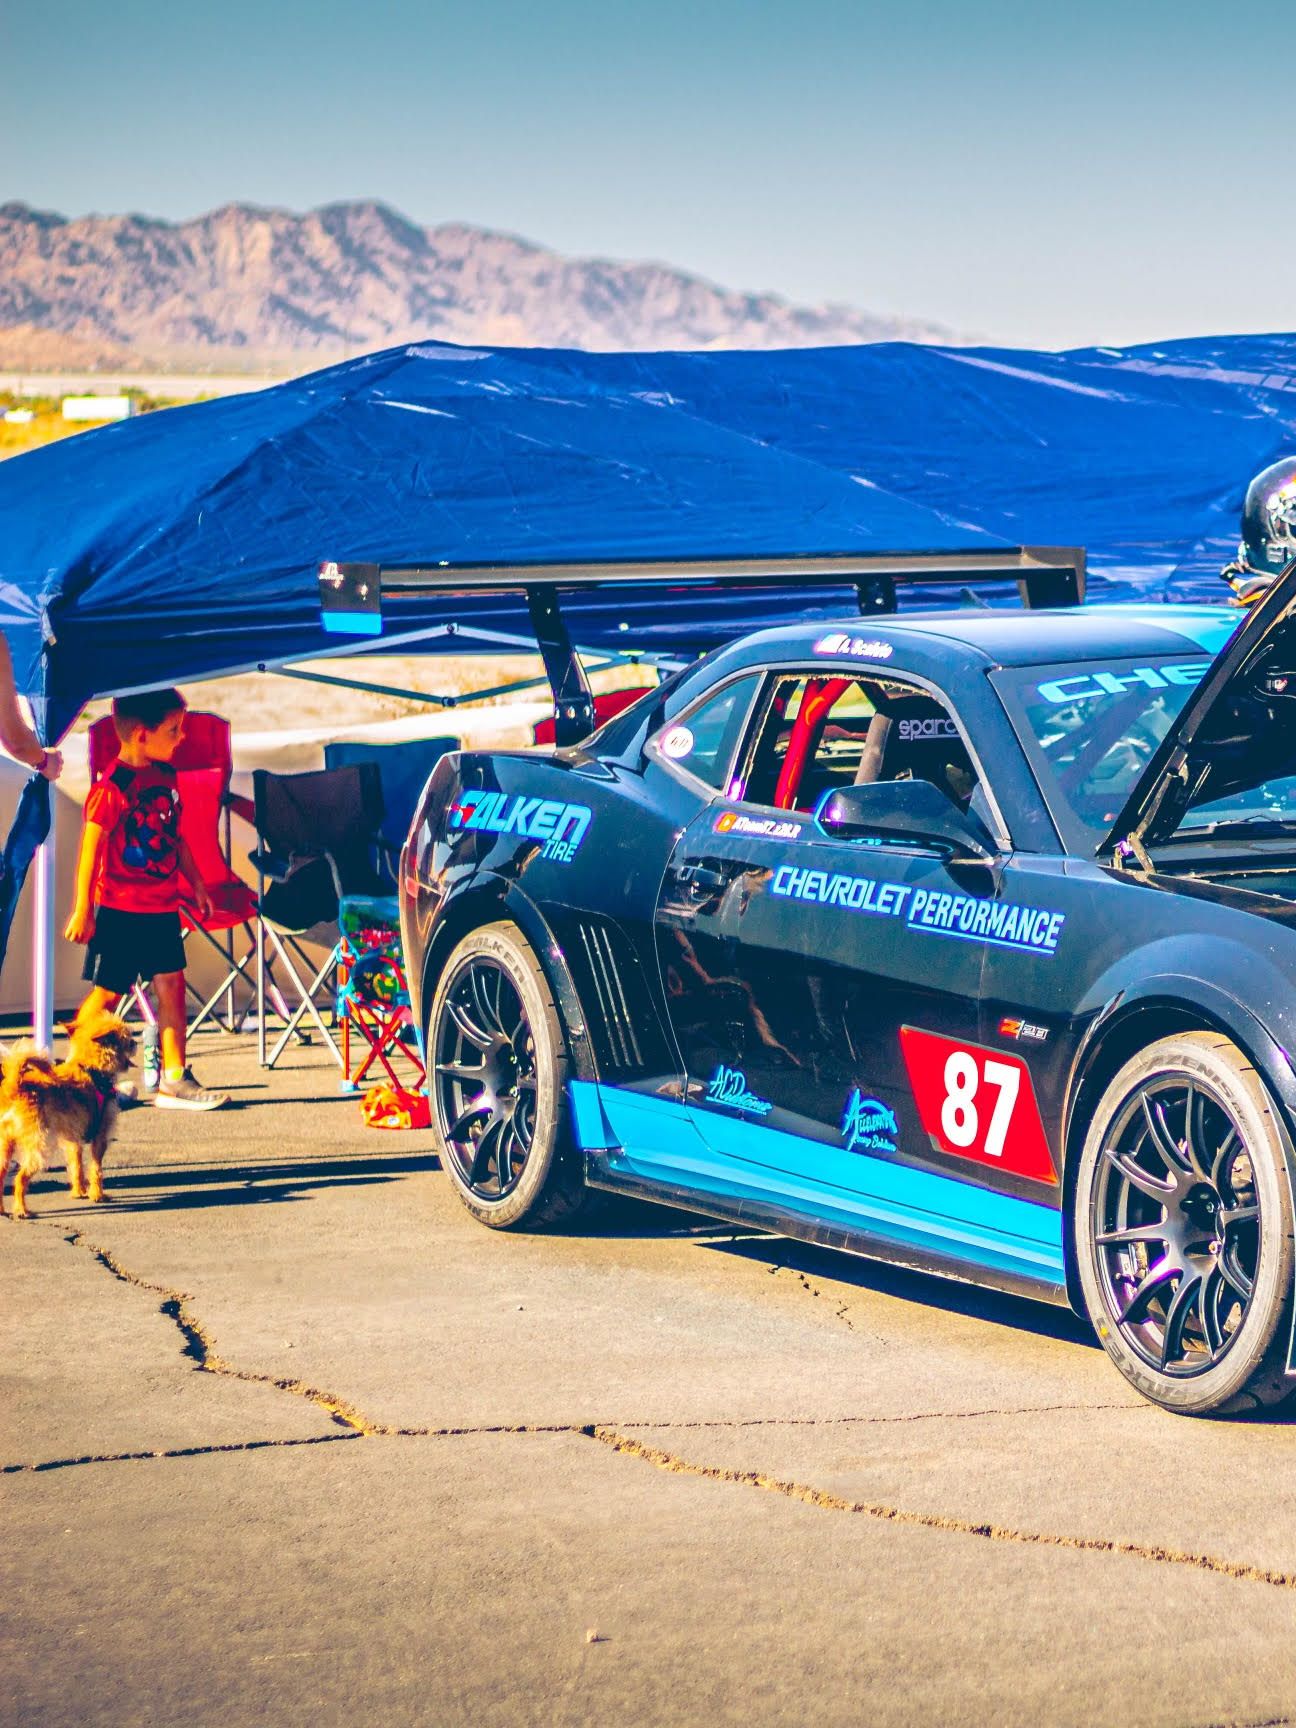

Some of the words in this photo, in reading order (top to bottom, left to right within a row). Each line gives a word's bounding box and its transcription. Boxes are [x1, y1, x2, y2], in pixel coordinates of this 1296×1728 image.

[451, 790, 592, 844] FALKEN
[542, 839, 578, 862] TIRE
[772, 865, 911, 915] CHEVROLET
[908, 888, 1065, 948] PERFORMANCE
[1144, 1053, 1235, 1100] AZENIS
[941, 1051, 1020, 1157] 87
